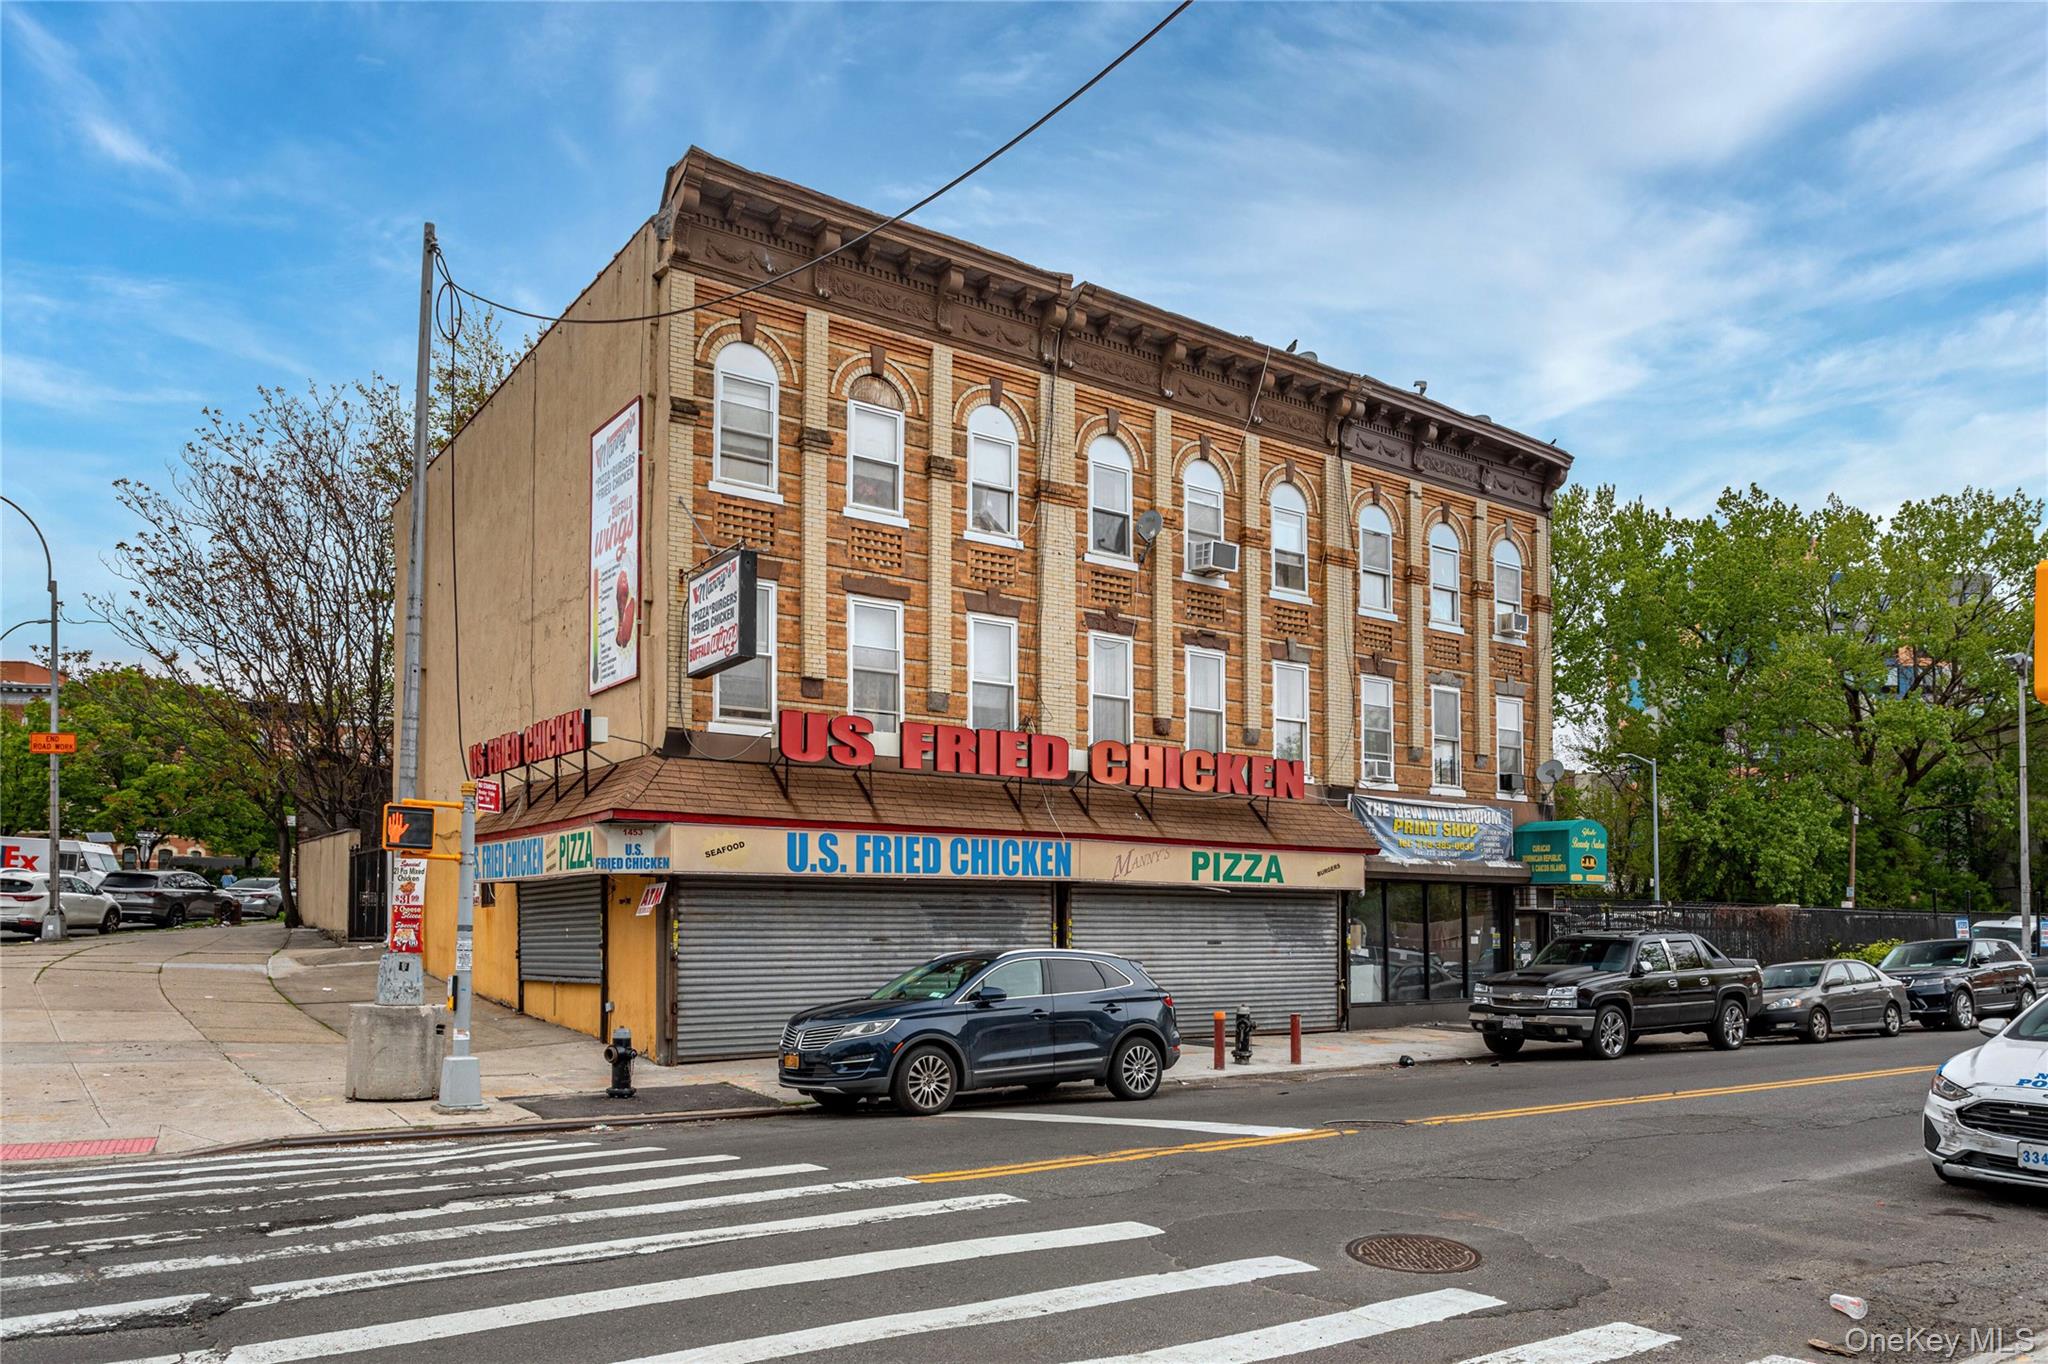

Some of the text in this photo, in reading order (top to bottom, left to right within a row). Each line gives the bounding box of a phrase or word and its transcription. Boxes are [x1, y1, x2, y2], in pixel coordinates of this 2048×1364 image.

[612, 454, 635, 477] BURGERS
[597, 483, 611, 501] FRIED
[612, 466, 634, 490] CHICKEN
[595, 509, 633, 561] wings
[694, 593, 737, 622] PIZZA BURGERS
[693, 608, 734, 636] FRIED CHICKEN
[690, 624, 738, 662] BUFFALO wings
[45, 735, 60, 743] END
[469, 709, 585, 779] US FRIED CHICKEN
[779, 710, 1304, 799] US FRIED CHICKEN
[1366, 802, 1501, 824] THE NEW MILLENNIUM
[1393, 818, 1438, 836] PRINT
[1443, 823, 1479, 838] SHOP
[482, 844, 504, 878] FRIED
[506, 837, 543, 877] CHICKEN
[559, 831, 593, 871] PIZZA
[625, 843, 644, 855] U.S.
[704, 841, 745, 858] SEAFOOD
[786, 832, 1072, 878] U.S. FRIED CHICKEN
[595, 857, 669, 870] FRIED CHICKEN
[1191, 851, 1284, 883] PIZZA
[1316, 863, 1341, 878] BURGERS
[641, 887, 664, 906] ATM
[2016, 1078, 2048, 1087] PO
